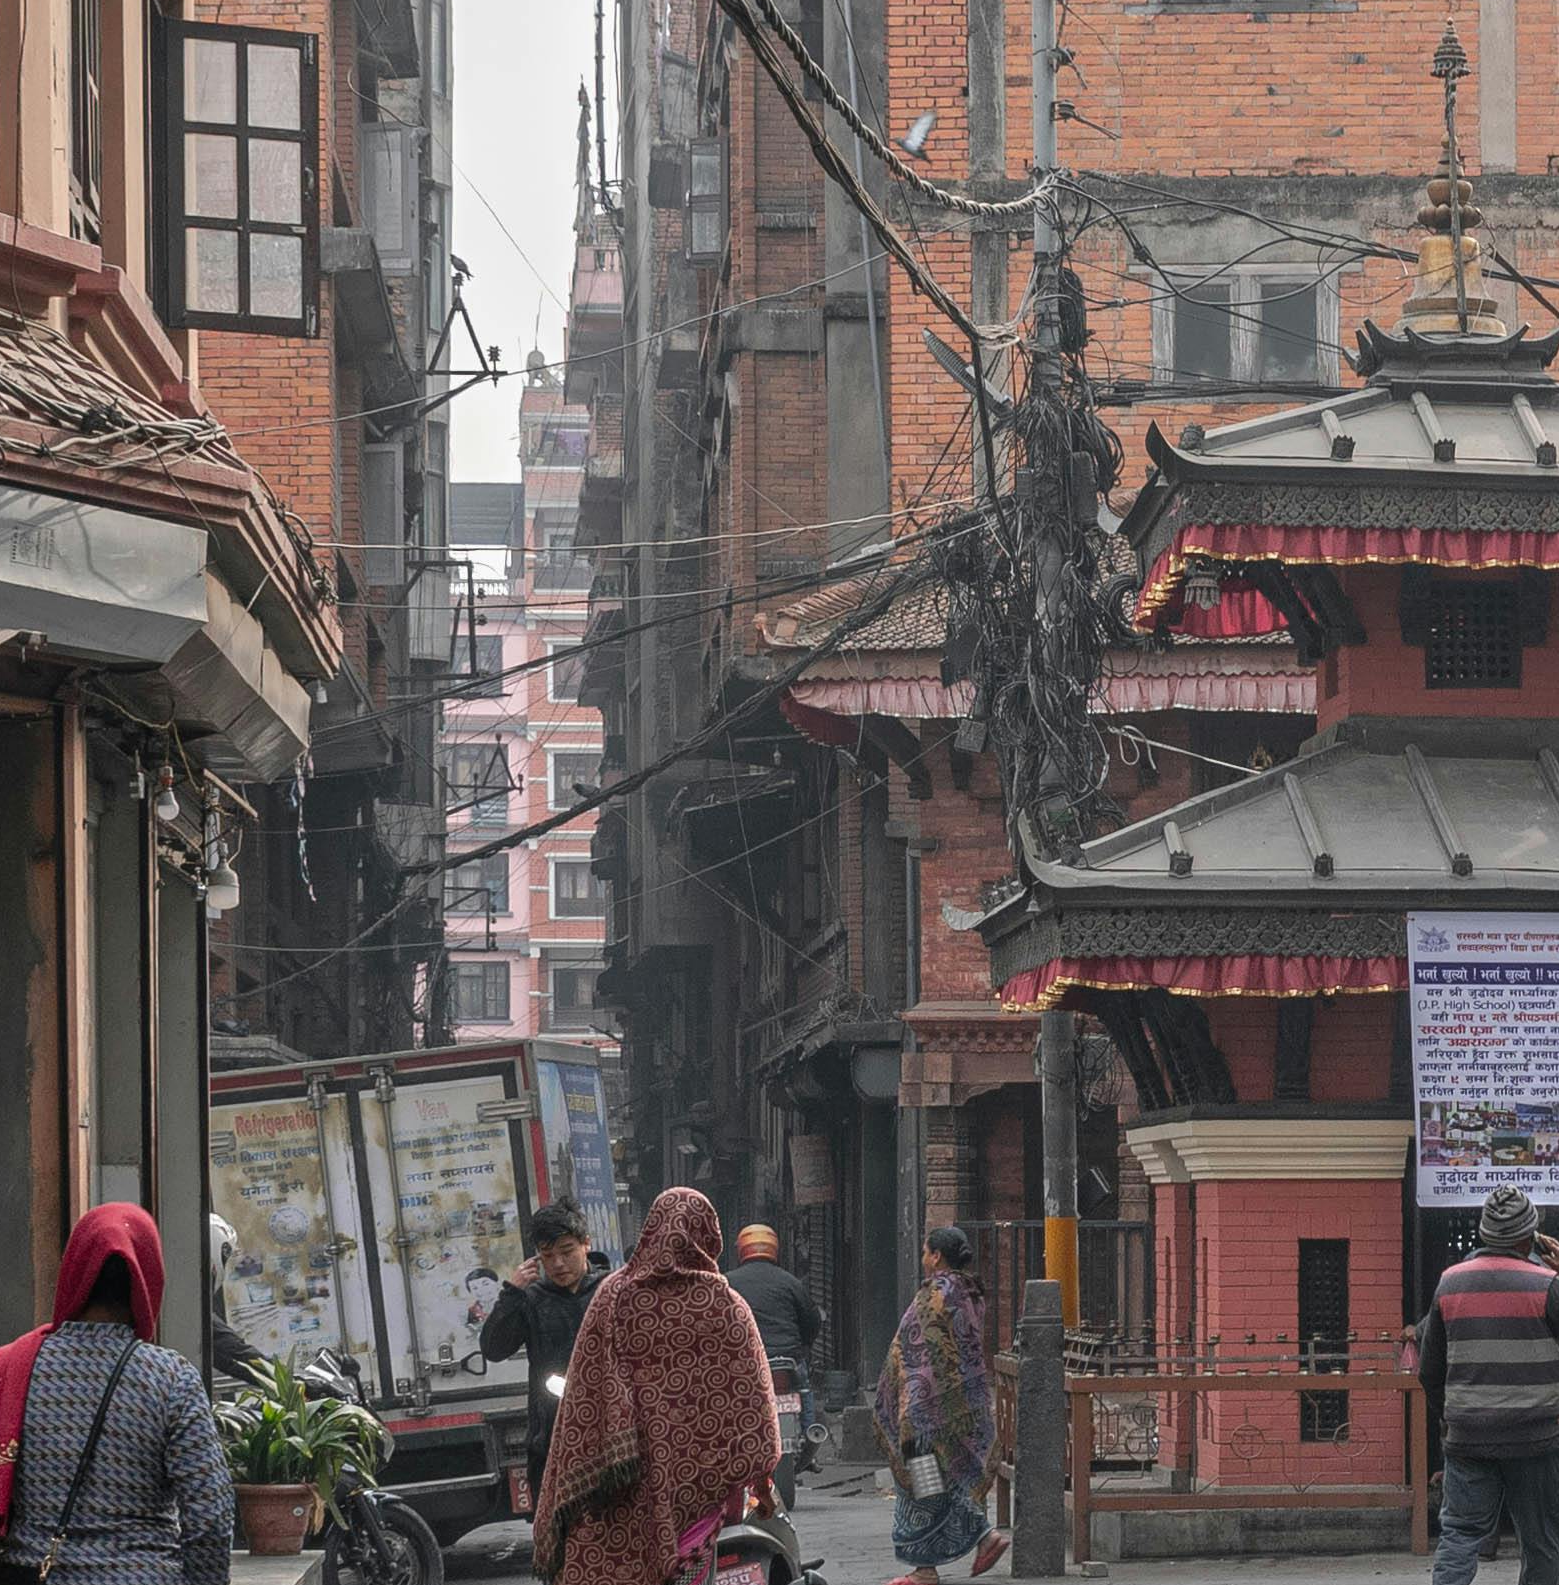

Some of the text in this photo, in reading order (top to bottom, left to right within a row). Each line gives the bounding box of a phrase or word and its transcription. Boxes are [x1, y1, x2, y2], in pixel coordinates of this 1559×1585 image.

[1509, 987, 1558, 997] माध्यमिक
[1442, 1000, 1470, 1012] High
[1473, 1000, 1516, 1012] School)
[1484, 1168, 1544, 1183] माध्यमिक
